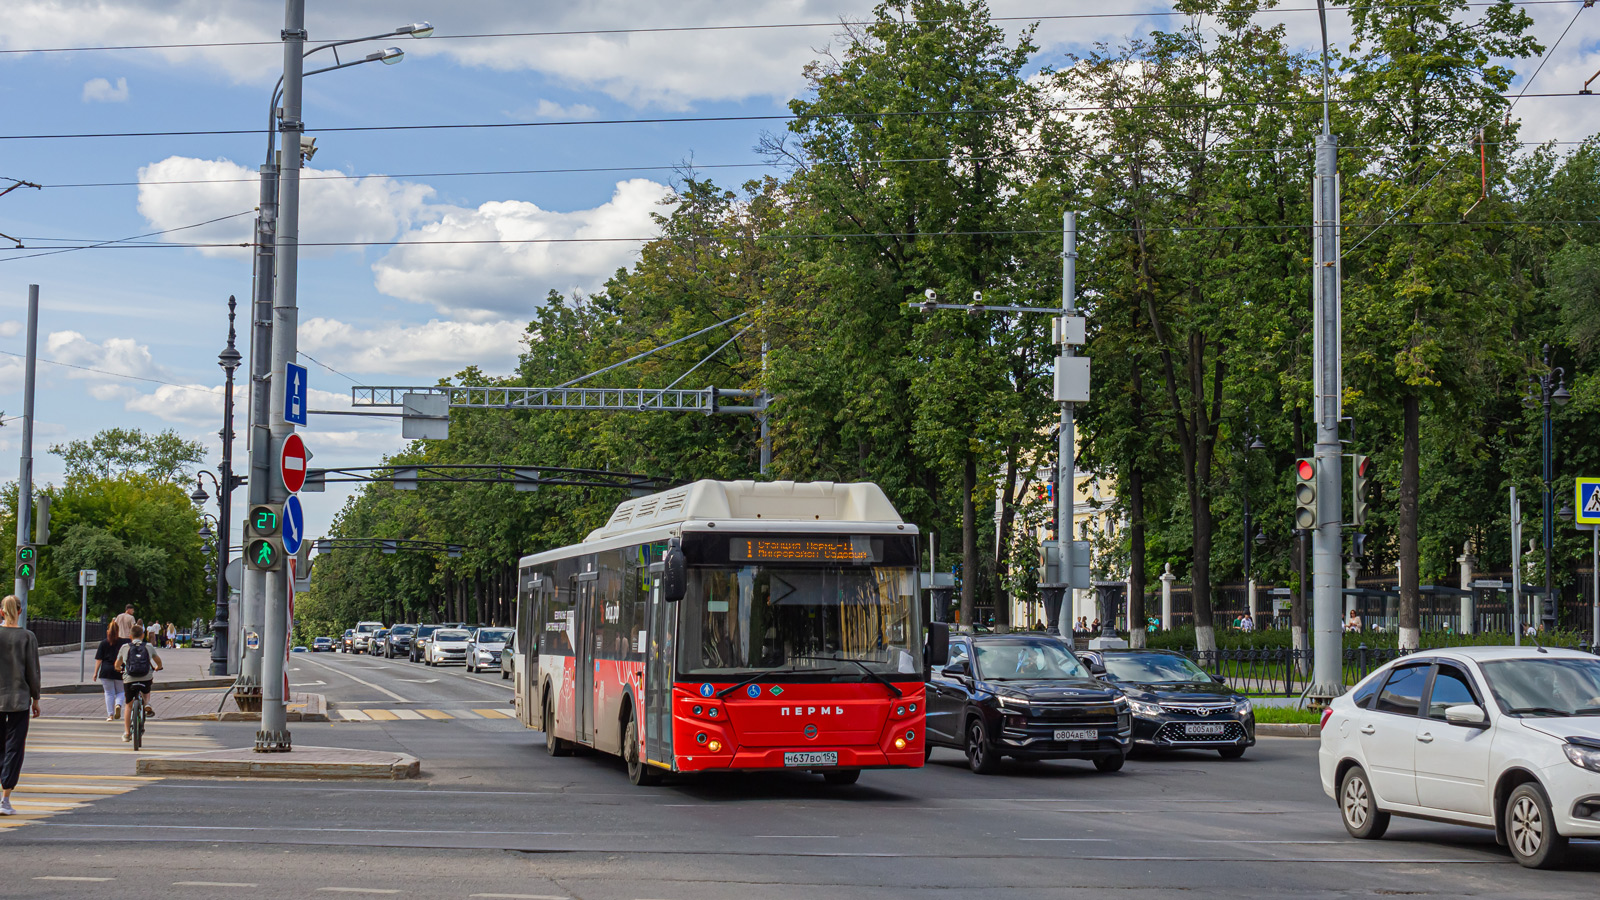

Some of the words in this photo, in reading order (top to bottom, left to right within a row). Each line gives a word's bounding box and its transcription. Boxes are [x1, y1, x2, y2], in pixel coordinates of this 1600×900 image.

[257, 512, 276, 529] 27
[21, 549, 33, 559] 27
[747, 541, 753, 557] 1
[758, 541, 801, 550] Станция
[758, 550, 819, 559] Микрорайон
[824, 550, 867, 559] Садовый
[781, 706, 844, 716] ПЕРМЬ
